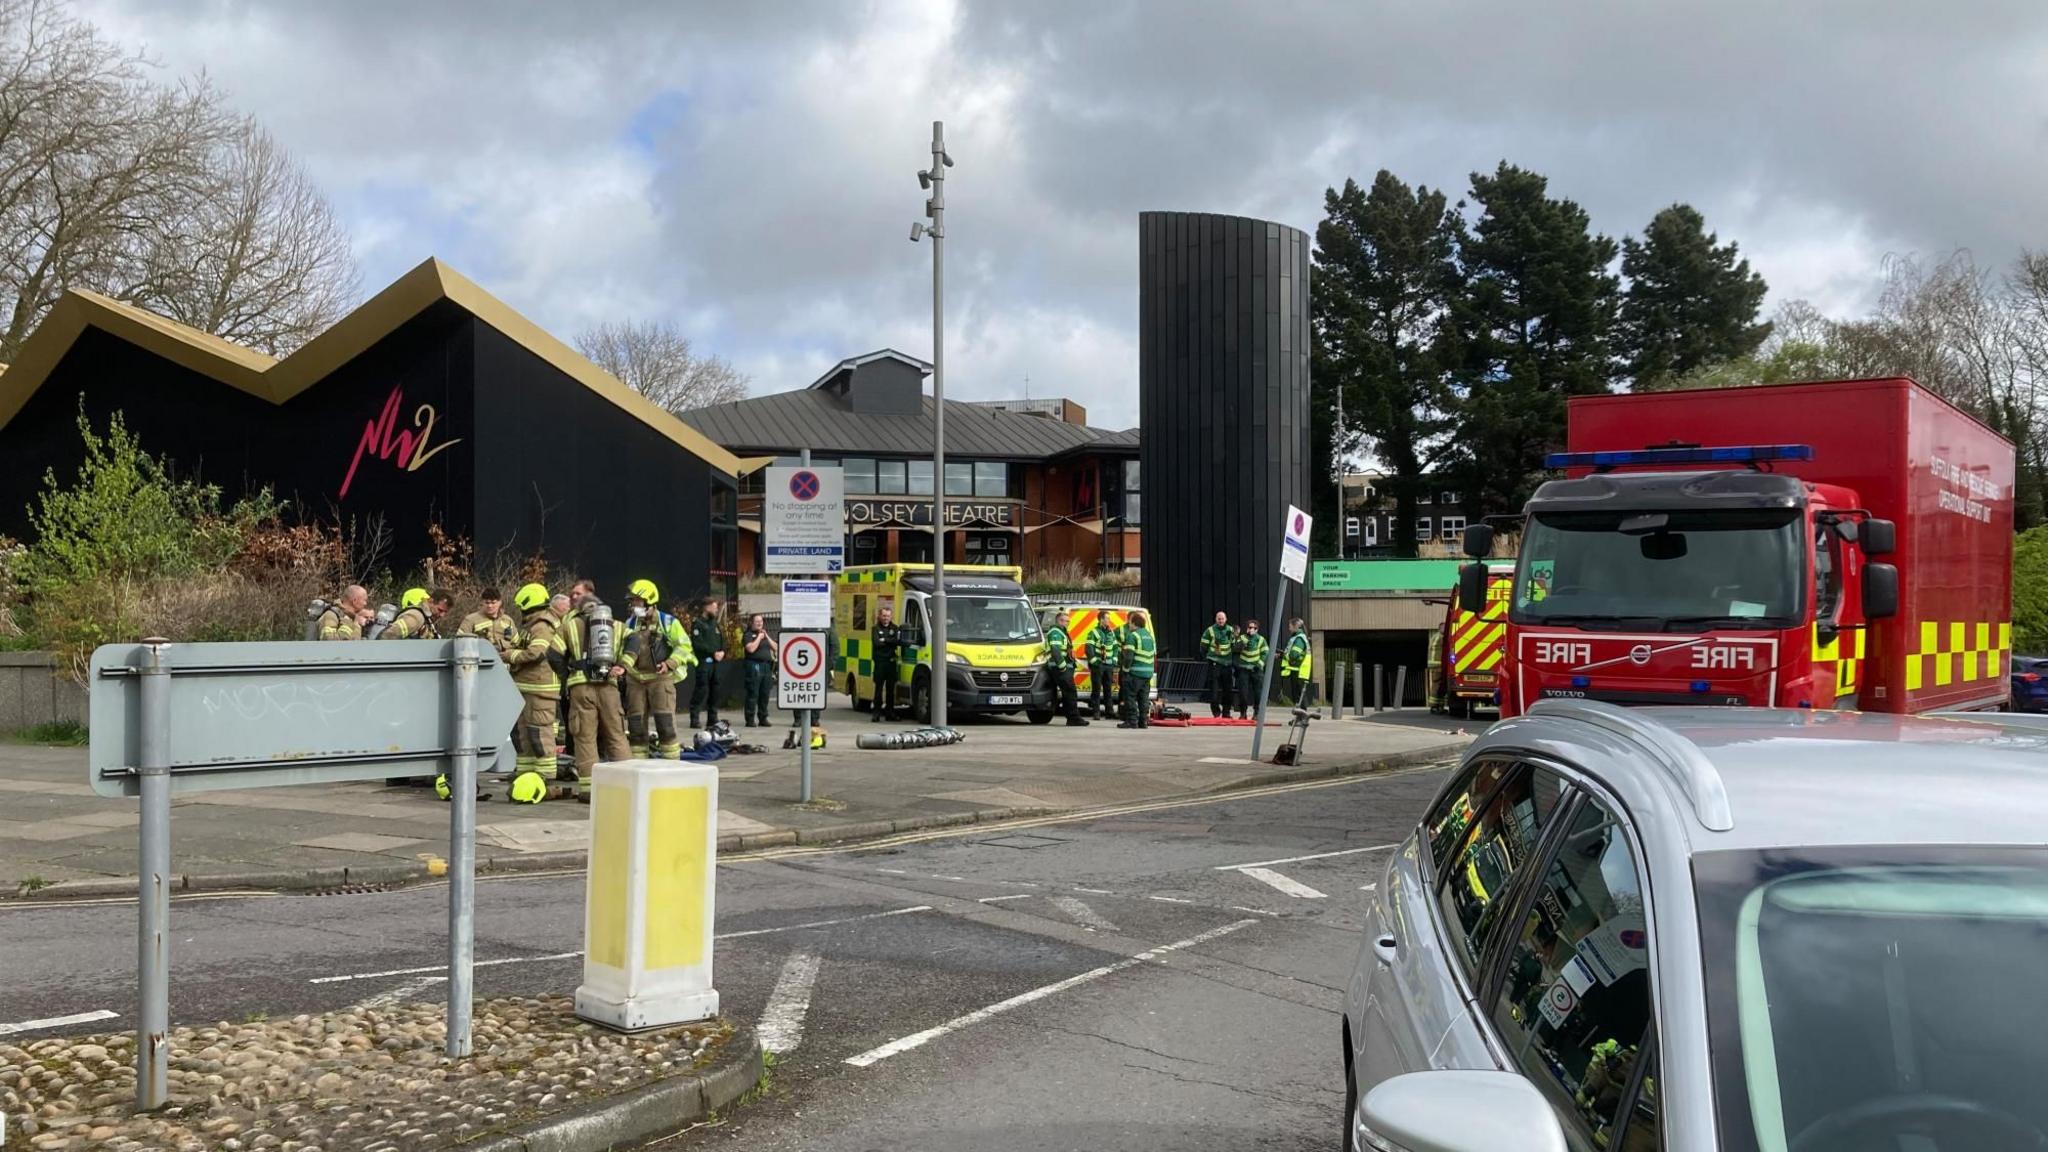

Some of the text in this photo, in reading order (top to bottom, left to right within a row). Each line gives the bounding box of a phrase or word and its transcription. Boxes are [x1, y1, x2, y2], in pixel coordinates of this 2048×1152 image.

[772, 503, 837, 512] No stopping at
[785, 512, 801, 520] any
[778, 547, 832, 555] PRIVATE LAND
[797, 650, 809, 666] 5
[783, 682, 821, 692] SPEED
[1545, 689, 1585, 698] VOLVO
[786, 694, 818, 703] LIMIT
[1726, 697, 1741, 705] FL
